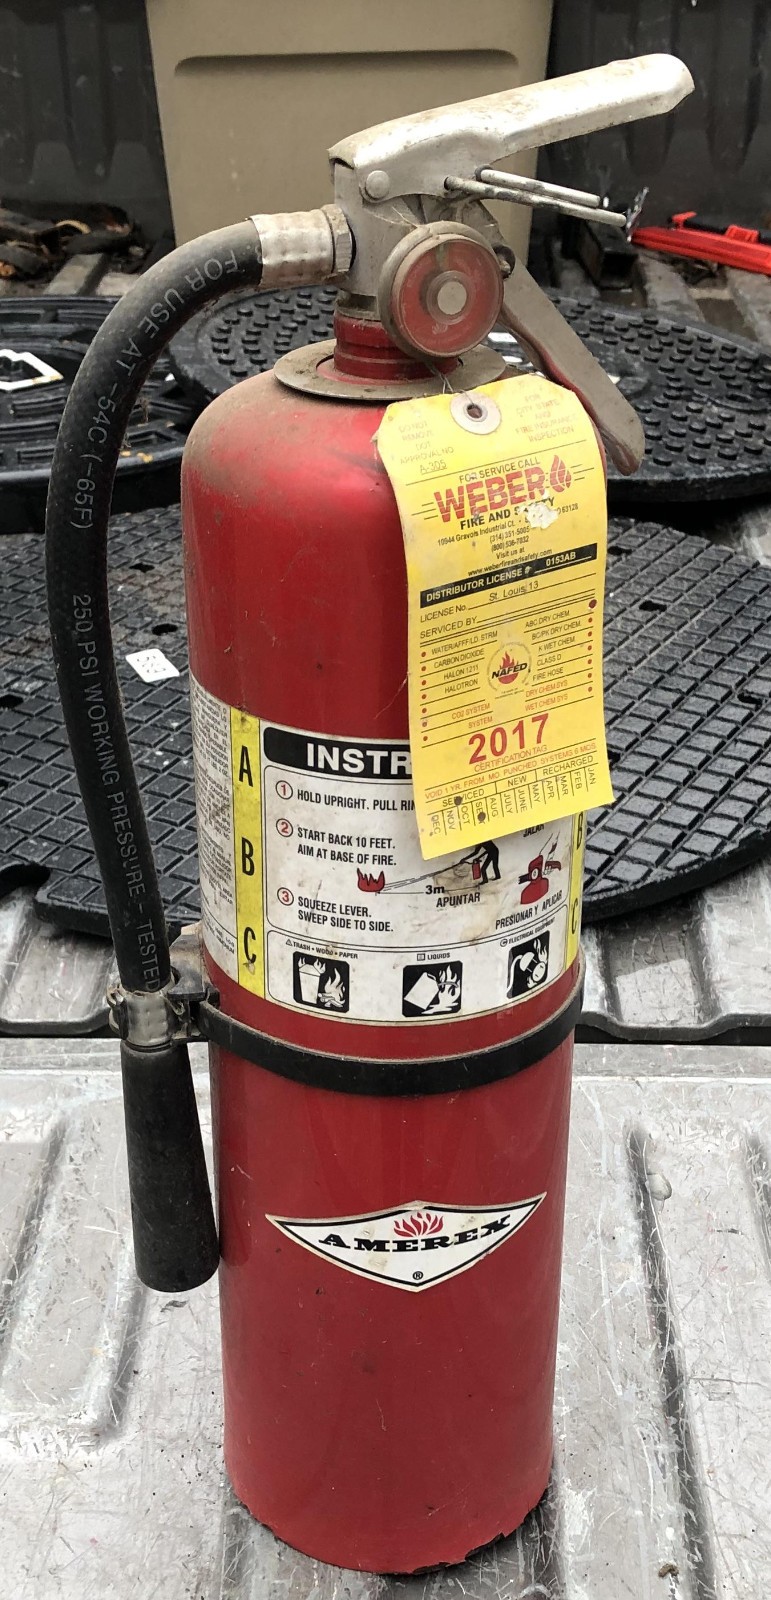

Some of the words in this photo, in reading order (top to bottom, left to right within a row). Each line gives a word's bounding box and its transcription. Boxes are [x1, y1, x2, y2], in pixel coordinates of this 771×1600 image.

[185, 250, 240, 292] FOR
[137, 288, 185, 339] USE
[116, 337, 143, 376] AT
[529, 426, 574, 443] INSPECTION
[401, 450, 440, 464] APPROVAL
[420, 460, 447, 473] A-305
[479, 463, 516, 478] SERVICE
[518, 457, 540, 468] CALL
[70, 454, 103, 529] (-65F)
[434, 467, 545, 522] WEBER
[460, 516, 485, 530] FIRE
[489, 509, 510, 522] AND
[456, 531, 478, 541] Gravois
[480, 522, 506, 535] Industrial
[490, 532, 504, 544] (314)
[505, 527, 530, 538] 351-5005
[492, 541, 504, 552] (800)
[496, 550, 509, 559] Visit
[468, 549, 552, 576] www.weberfireandsafety.com
[426, 578, 484, 602] DISTRIBUTOR
[486, 569, 522, 585] LICENSE
[546, 552, 576, 567] 0153AB
[420, 607, 454, 623] LICENSE
[503, 586, 525, 598] Louis
[529, 581, 538, 590] 13
[73, 595, 94, 632] 250
[525, 619, 537, 628] ABC
[539, 615, 551, 624] DRY
[420, 621, 462, 639] SERVICED
[466, 616, 477, 626] BY
[551, 626, 563, 634] DRY
[544, 640, 556, 650] WET
[78, 641, 99, 676] PSI
[434, 656, 459, 668] CARBON
[460, 648, 484, 659] DIOXIDE
[537, 656, 556, 666] CLASS
[444, 668, 464, 680] HALON
[466, 664, 478, 673] 1211
[492, 662, 528, 680] NAFED
[533, 672, 546, 681] FIRE
[547, 667, 564, 677] HOSE
[445, 679, 478, 693] HALOTRON
[526, 688, 538, 698] DRY
[539, 683, 556, 693] CHEM
[452, 711, 464, 719] CO2
[465, 703, 490, 715] SYSTEM
[525, 702, 538, 711] WET
[539, 697, 556, 707] CHEM
[468, 716, 493, 728] SYSTEM
[84, 683, 120, 785] WORKING
[468, 713, 549, 764] 2017
[238, 745, 254, 788] A
[474, 750, 531, 772] CERTIFICATION
[533, 745, 547, 754] TAG
[543, 755, 593, 776] RECHARGED
[425, 790, 442, 799] VOID
[464, 776, 484, 788] FROM
[504, 761, 537, 776] PUNCHED
[541, 750, 572, 764] SYSTEMS
[508, 775, 526, 787] NEW
[574, 772, 582, 789] FEB
[588, 768, 596, 784] JAN
[443, 789, 484, 807] SEVICED
[546, 780, 554, 798] APR
[298, 789, 321, 803] HOLD
[324, 794, 369, 810] UPRIGHT.
[373, 800, 398, 810] PULL
[490, 798, 499, 817] AUG
[504, 794, 513, 813] JULY
[518, 790, 527, 812] JUNE
[431, 814, 440, 834] DEC
[447, 810, 455, 830] NOV
[461, 806, 470, 824] OCT
[107, 792, 146, 897] PRESSURE
[298, 827, 326, 842] START
[328, 832, 352, 846] BACK
[356, 837, 366, 847] 10
[370, 838, 396, 849] FEET.
[241, 837, 255, 876] B
[298, 844, 314, 856] AIM
[316, 848, 327, 859] AT
[330, 850, 354, 863] BASE
[357, 854, 369, 864] OF
[372, 855, 396, 866] FIRE.
[425, 885, 445, 894] 3m
[436, 892, 480, 907] APUNTAR
[298, 896, 337, 913] SQUEEZE
[340, 904, 372, 917] LEVER.
[496, 907, 532, 930] PRESIONAR
[534, 905, 539, 915] Y
[542, 890, 562, 911] APLICAR
[572, 897, 578, 934] C
[298, 910, 328, 925] SWEEP
[330, 917, 351, 929] SIDE
[354, 920, 366, 930] TO
[369, 922, 394, 932] SIDE.
[509, 928, 534, 944] ELECTRICAL
[535, 917, 556, 933] EQUIPMENT
[136, 918, 161, 992] TESTED
[243, 927, 256, 964] C
[293, 941, 310, 951] TRASH
[316, 947, 333, 956] WOOD
[318, 1214, 511, 1252] AMEREX
